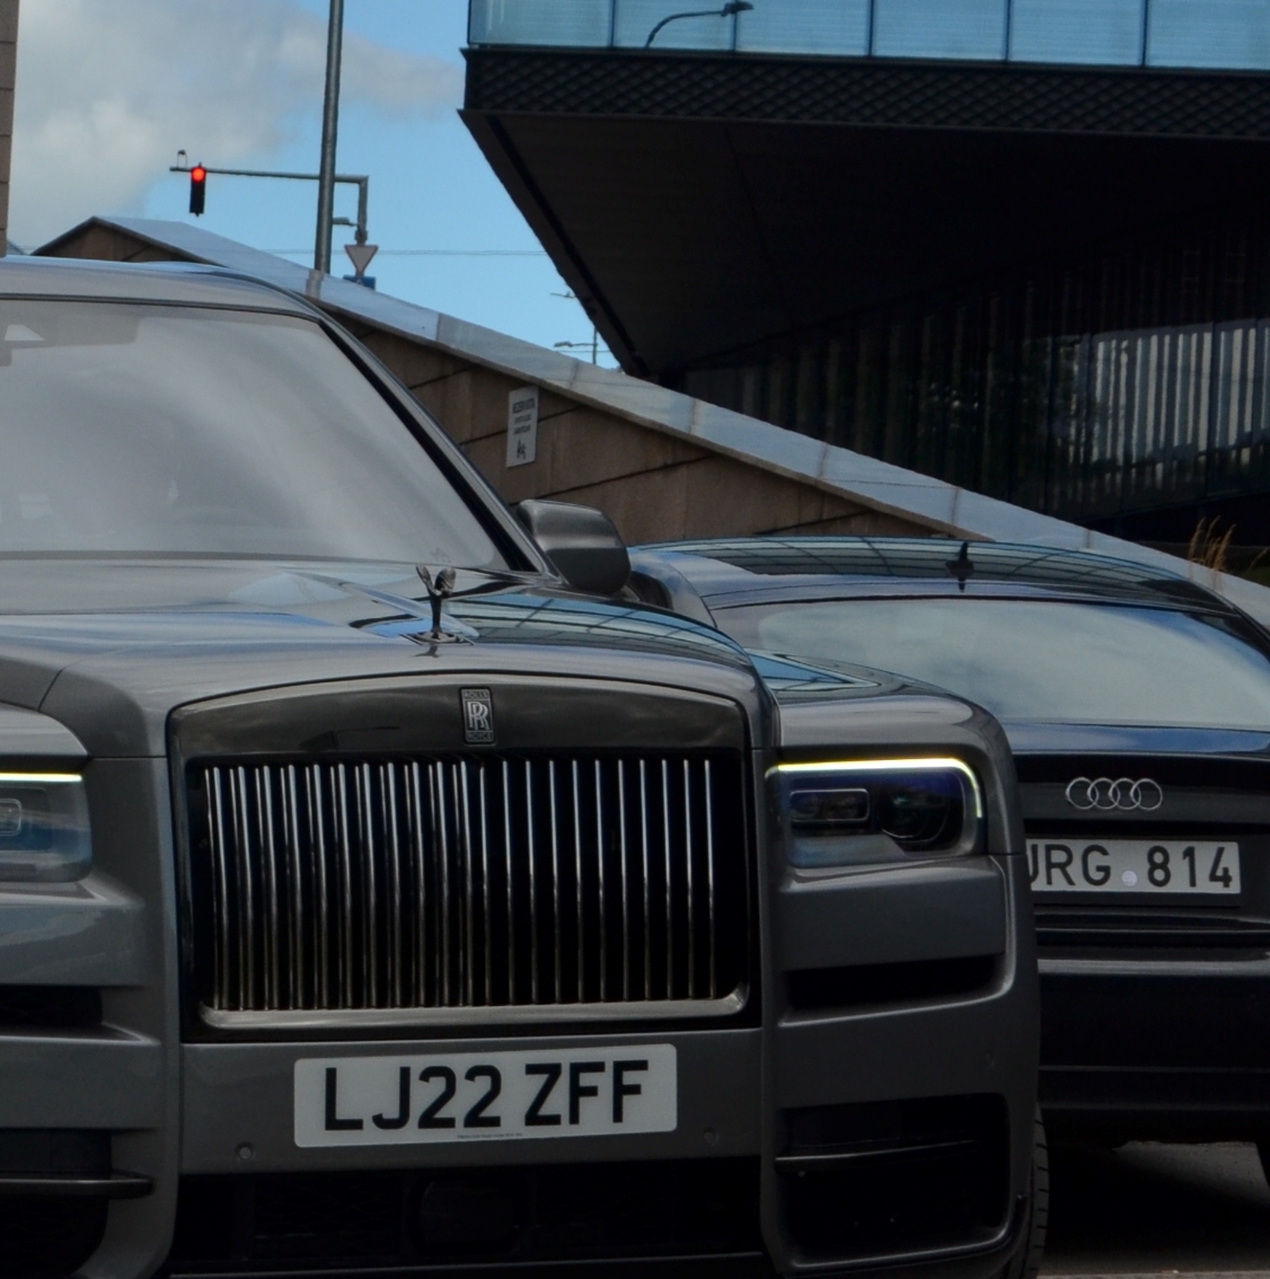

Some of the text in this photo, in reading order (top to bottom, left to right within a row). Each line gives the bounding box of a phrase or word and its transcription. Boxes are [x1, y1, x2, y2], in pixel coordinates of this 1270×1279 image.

[1147, 845, 1232, 888] 814
[324, 1059, 649, 1131] LJ22 ZFF
